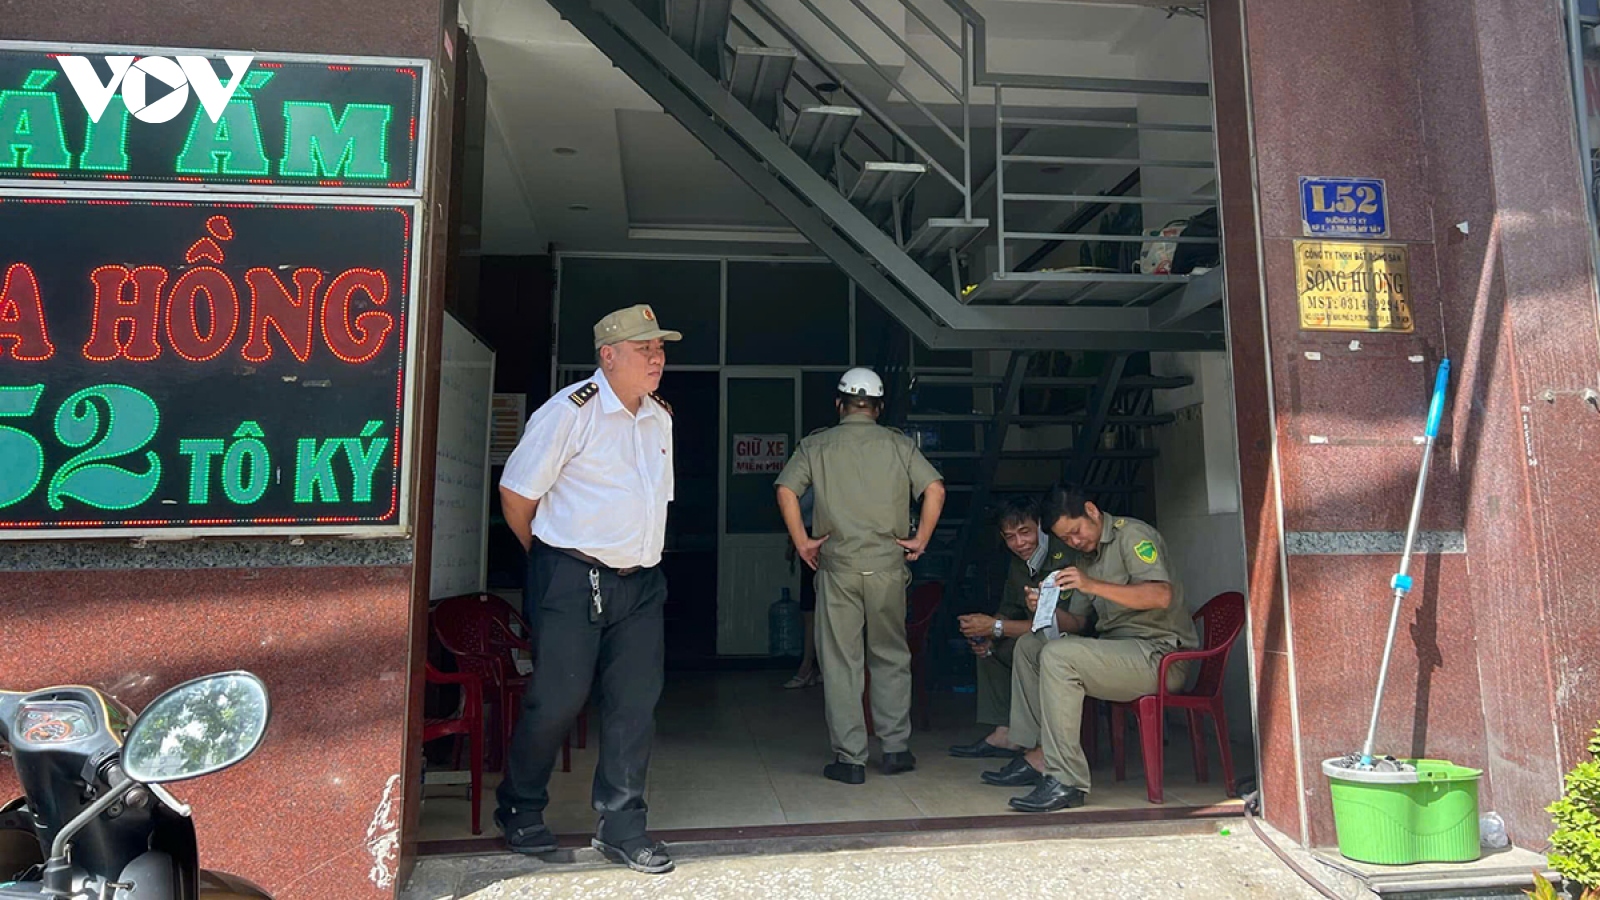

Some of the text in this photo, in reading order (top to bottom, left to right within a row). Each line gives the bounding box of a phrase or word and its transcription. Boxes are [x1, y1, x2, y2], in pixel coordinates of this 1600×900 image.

[1310, 185, 1378, 214] L52
[83, 215, 394, 363] HỒNG
[1306, 263, 1347, 292] SÔNG
[179, 420, 271, 504] TÔ
[293, 420, 389, 503] KÝ
[766, 440, 785, 456] XE
